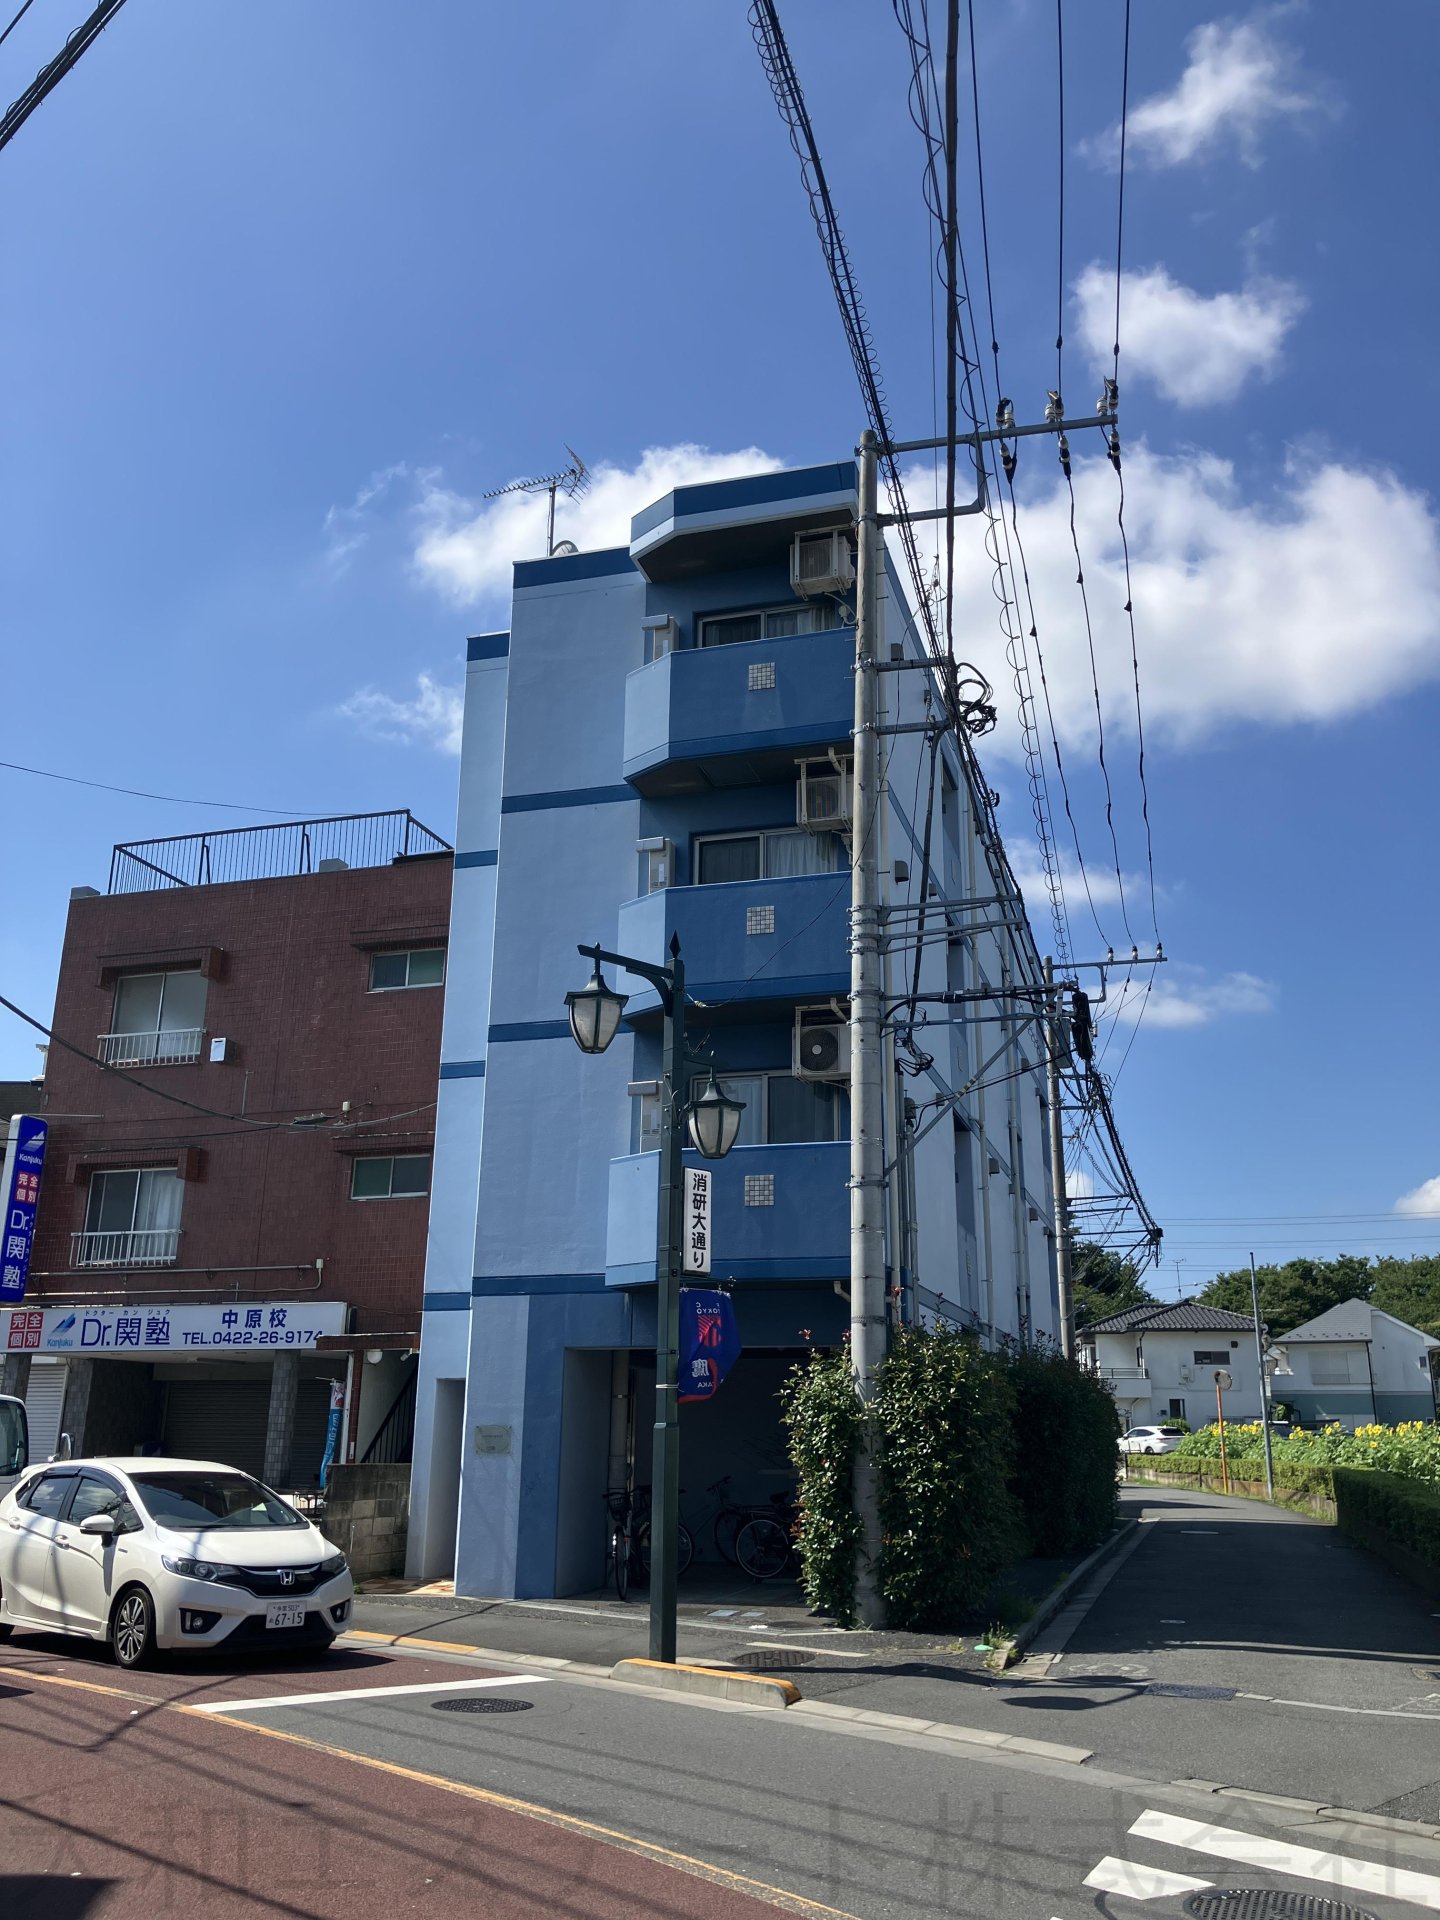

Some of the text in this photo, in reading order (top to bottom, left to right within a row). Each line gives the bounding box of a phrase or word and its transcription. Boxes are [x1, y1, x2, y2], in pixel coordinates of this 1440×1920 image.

[18, 1173, 39, 1188] 完全
[16, 1188, 37, 1203] 個別
[692, 1172, 707, 1269] 消研大通り
[1, 1209, 30, 1289] Dr.関塾
[12, 1314, 41, 1328] 完全
[222, 1308, 288, 1329] 中原校
[80, 1316, 171, 1347] Dr.関塾
[10, 1332, 39, 1347] 個別
[275, 1612, 303, 1625] 67-15
